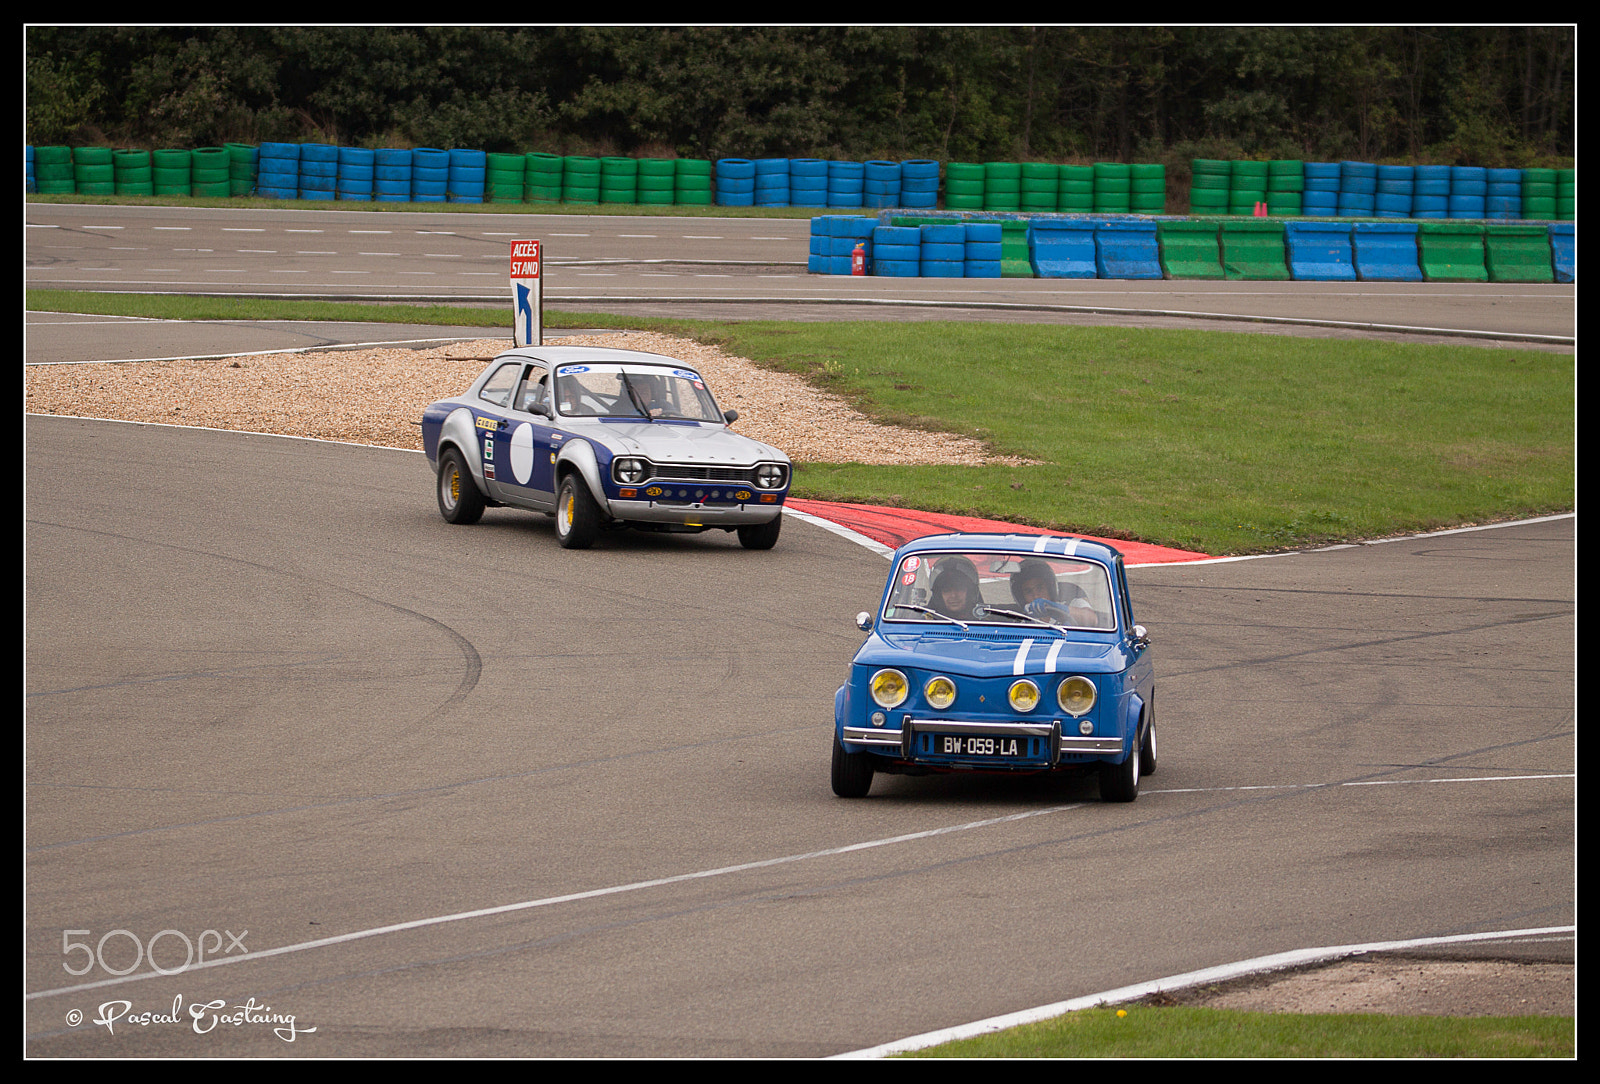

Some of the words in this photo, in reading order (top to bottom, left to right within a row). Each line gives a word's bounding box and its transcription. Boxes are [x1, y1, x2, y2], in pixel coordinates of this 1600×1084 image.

[512, 240, 538, 257] ACCÈS
[511, 261, 538, 275] STAND
[904, 574, 915, 583] 18
[943, 737, 1018, 756] BW-059-LA
